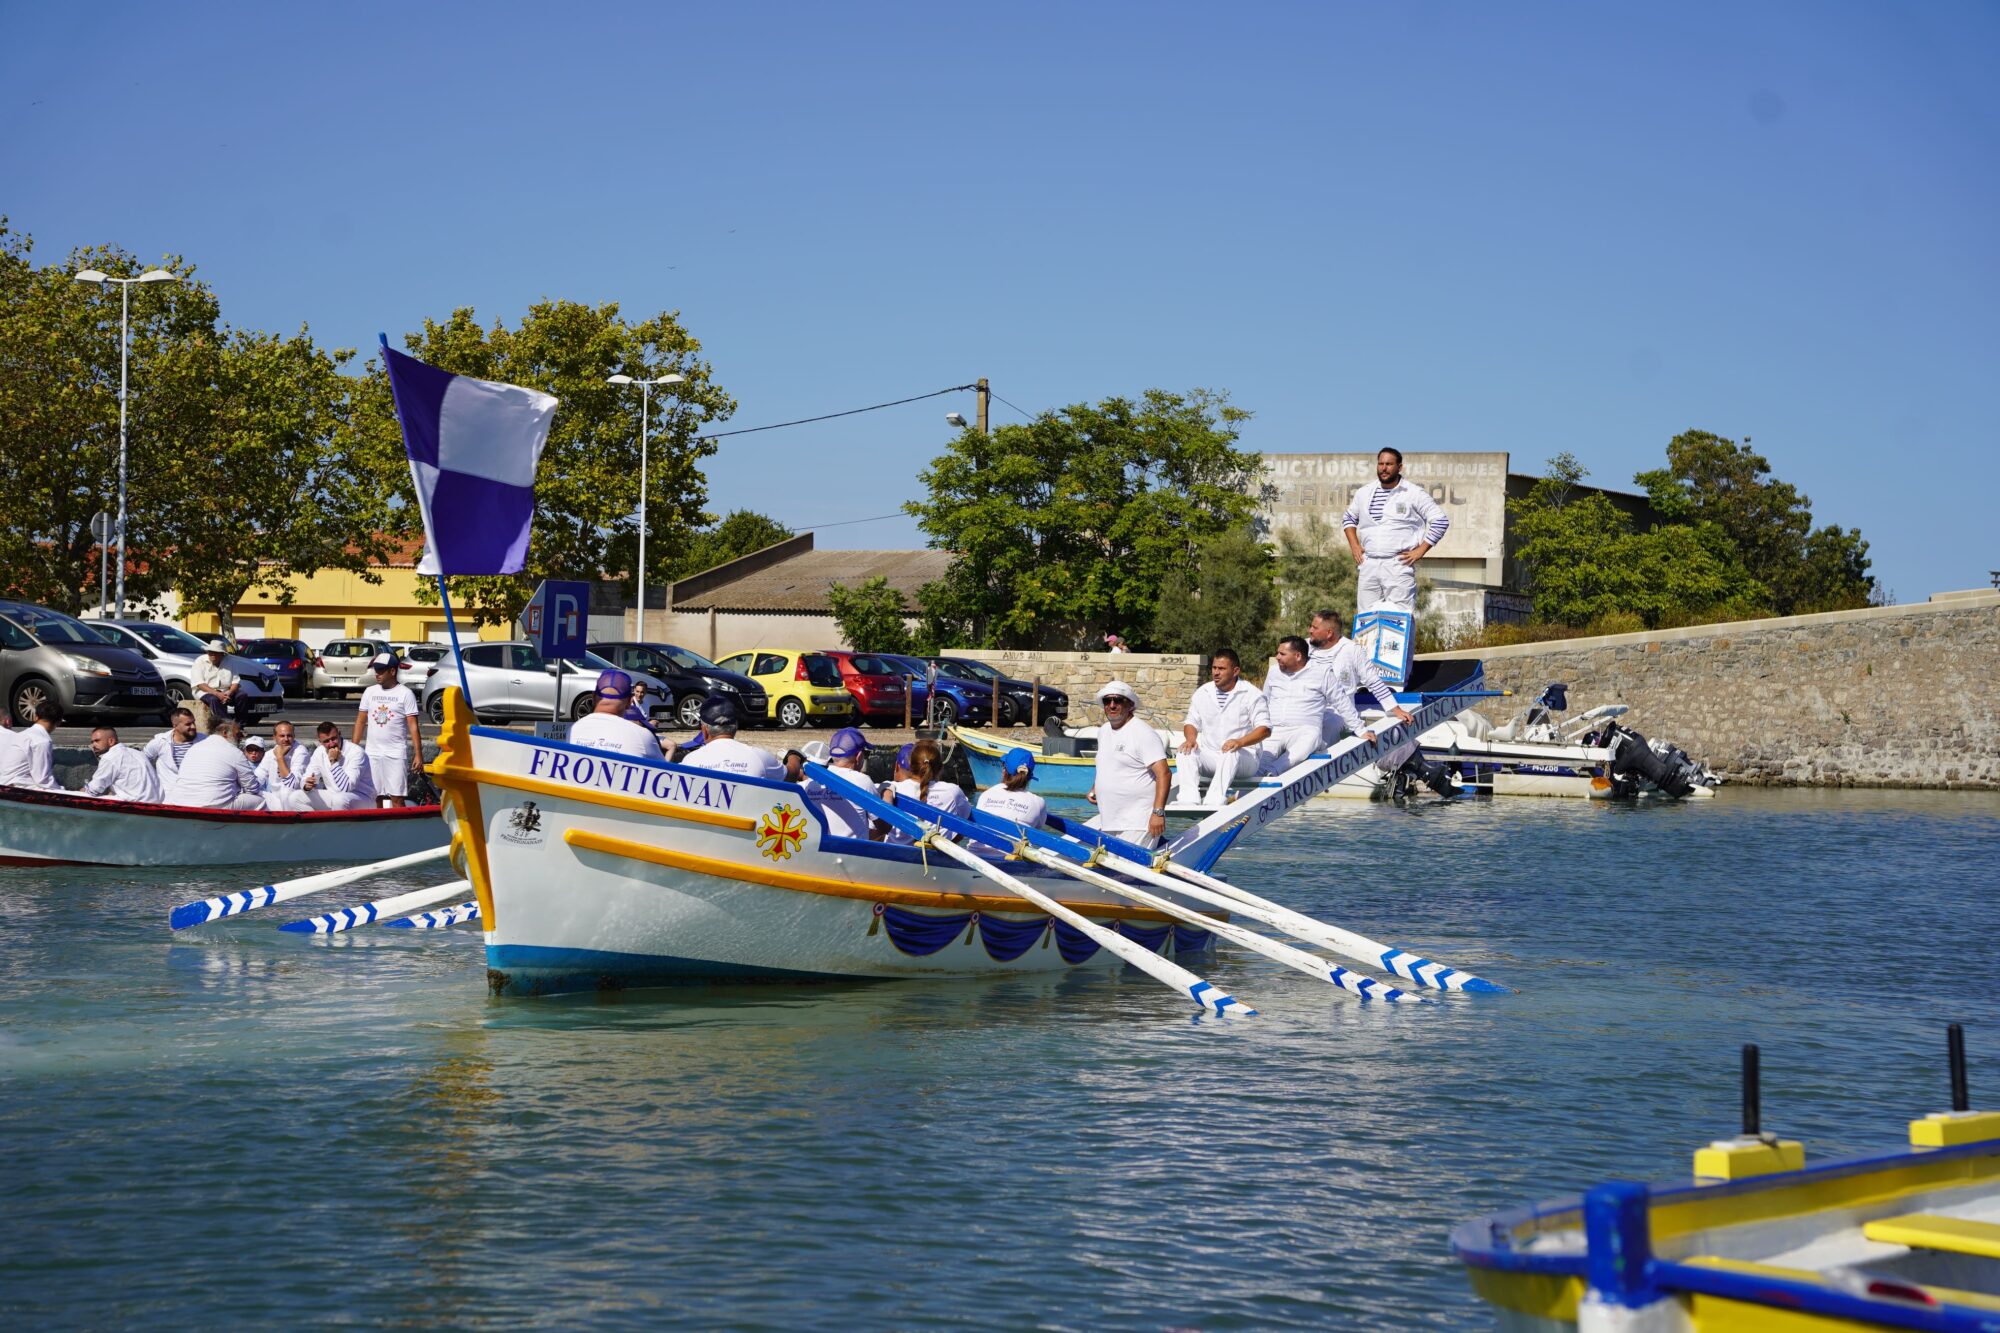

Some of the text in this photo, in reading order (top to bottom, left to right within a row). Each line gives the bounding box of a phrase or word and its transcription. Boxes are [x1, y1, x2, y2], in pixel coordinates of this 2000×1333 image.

[552, 593, 579, 646] P
[551, 724, 567, 732] SAUF
[1283, 696, 1465, 811] FRONTIGNAN SON MUSCAT
[528, 748, 738, 811] FRONTIGNAN
